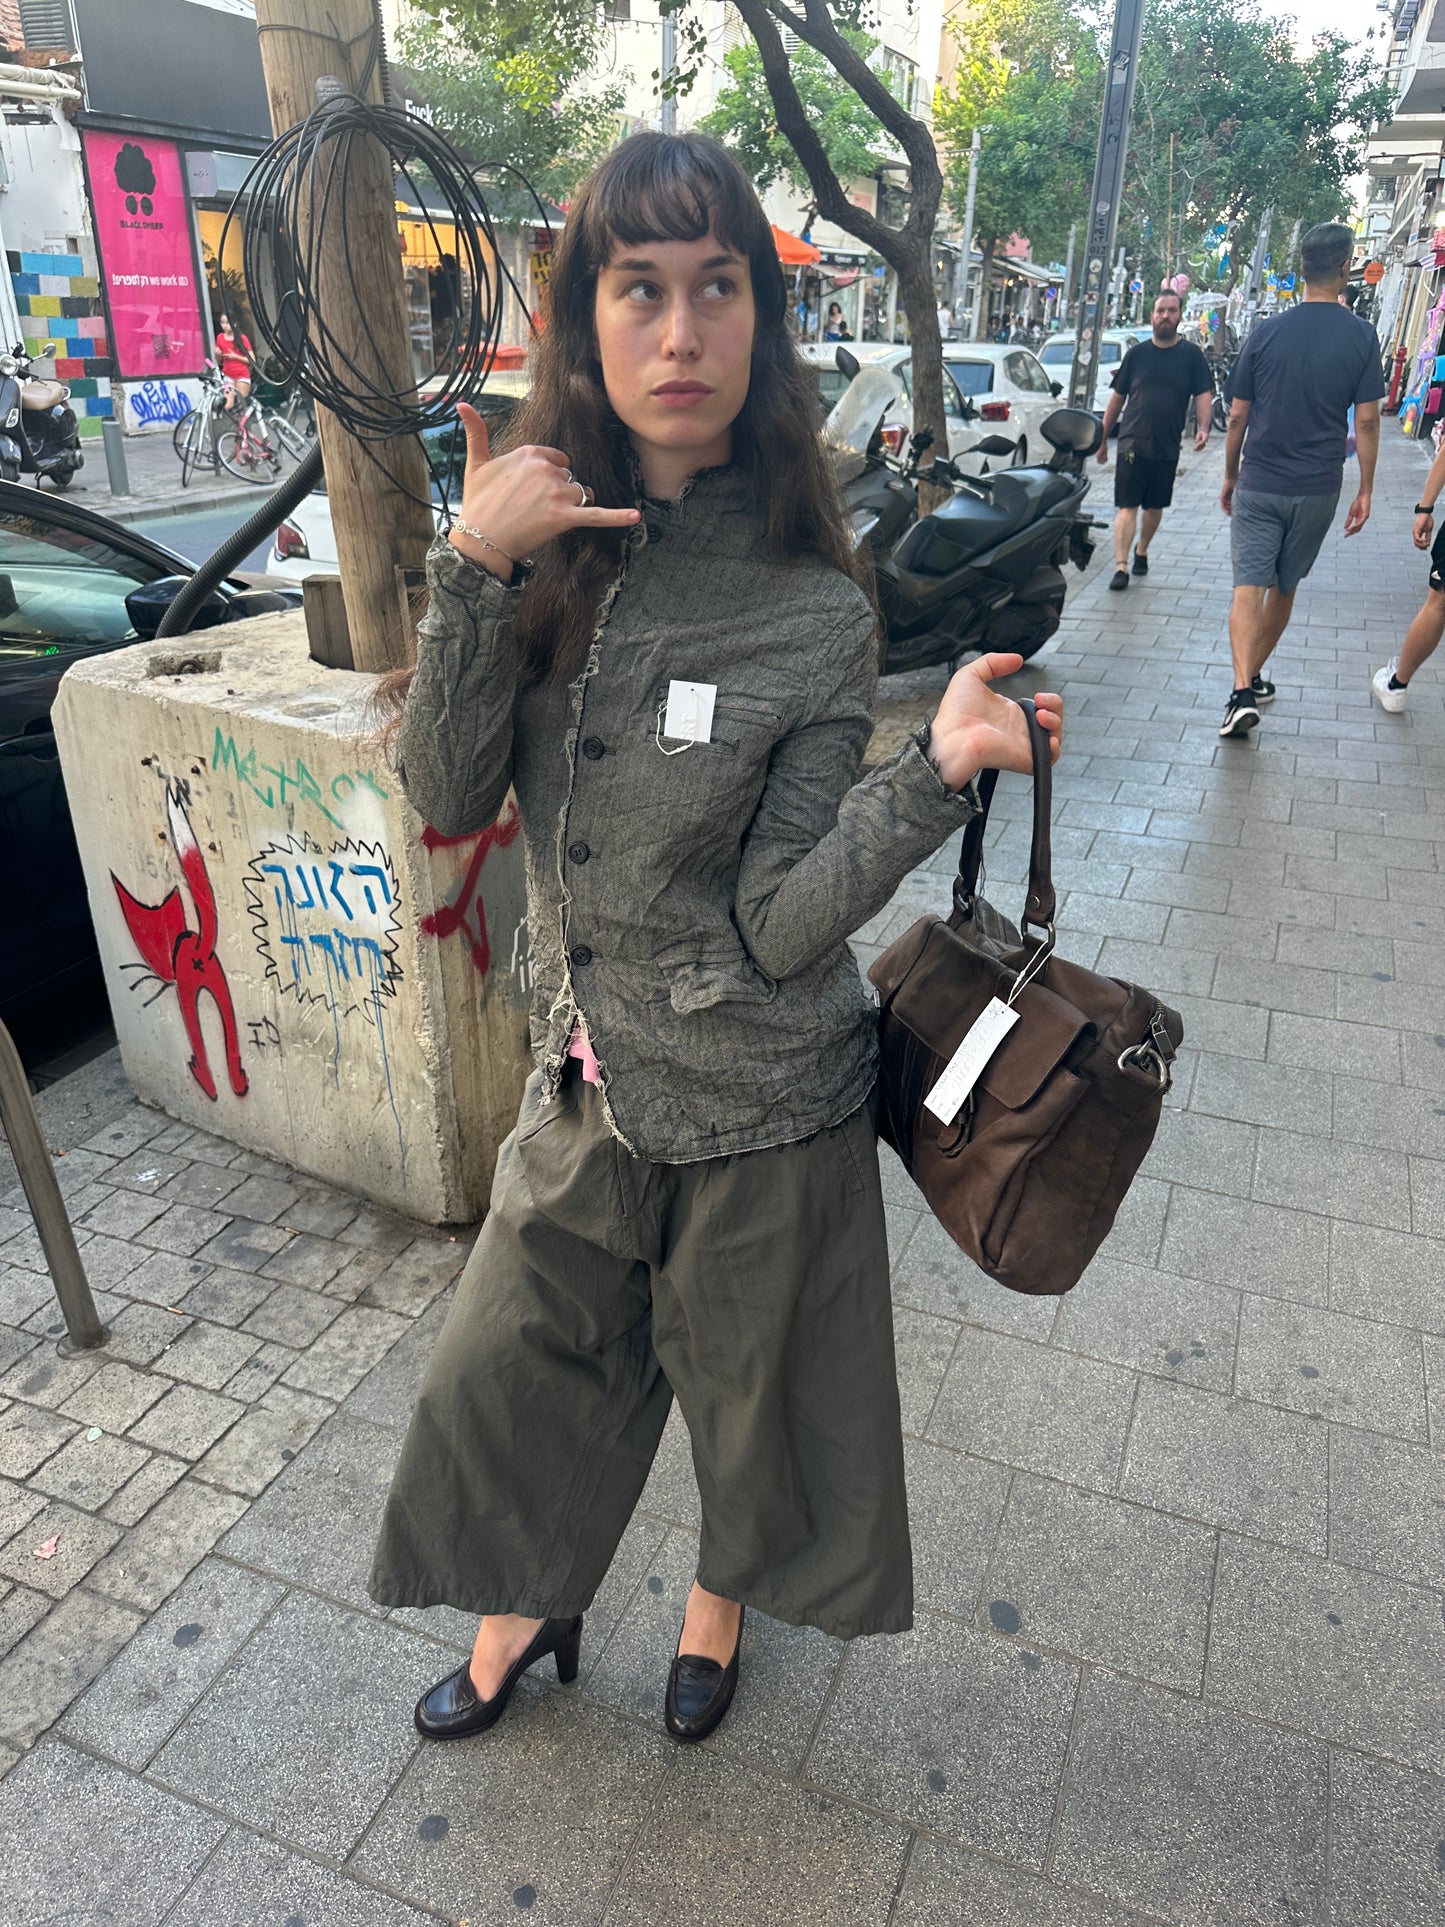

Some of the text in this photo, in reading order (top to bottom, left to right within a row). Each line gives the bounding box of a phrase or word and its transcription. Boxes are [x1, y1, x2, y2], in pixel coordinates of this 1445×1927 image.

[405, 99, 434, 127] Fuck
[120, 220, 163, 230] BLACK SHEEP
[149, 276, 160, 286] we
[160, 274, 178, 286] work
[261, 861, 392, 921] הזונה
